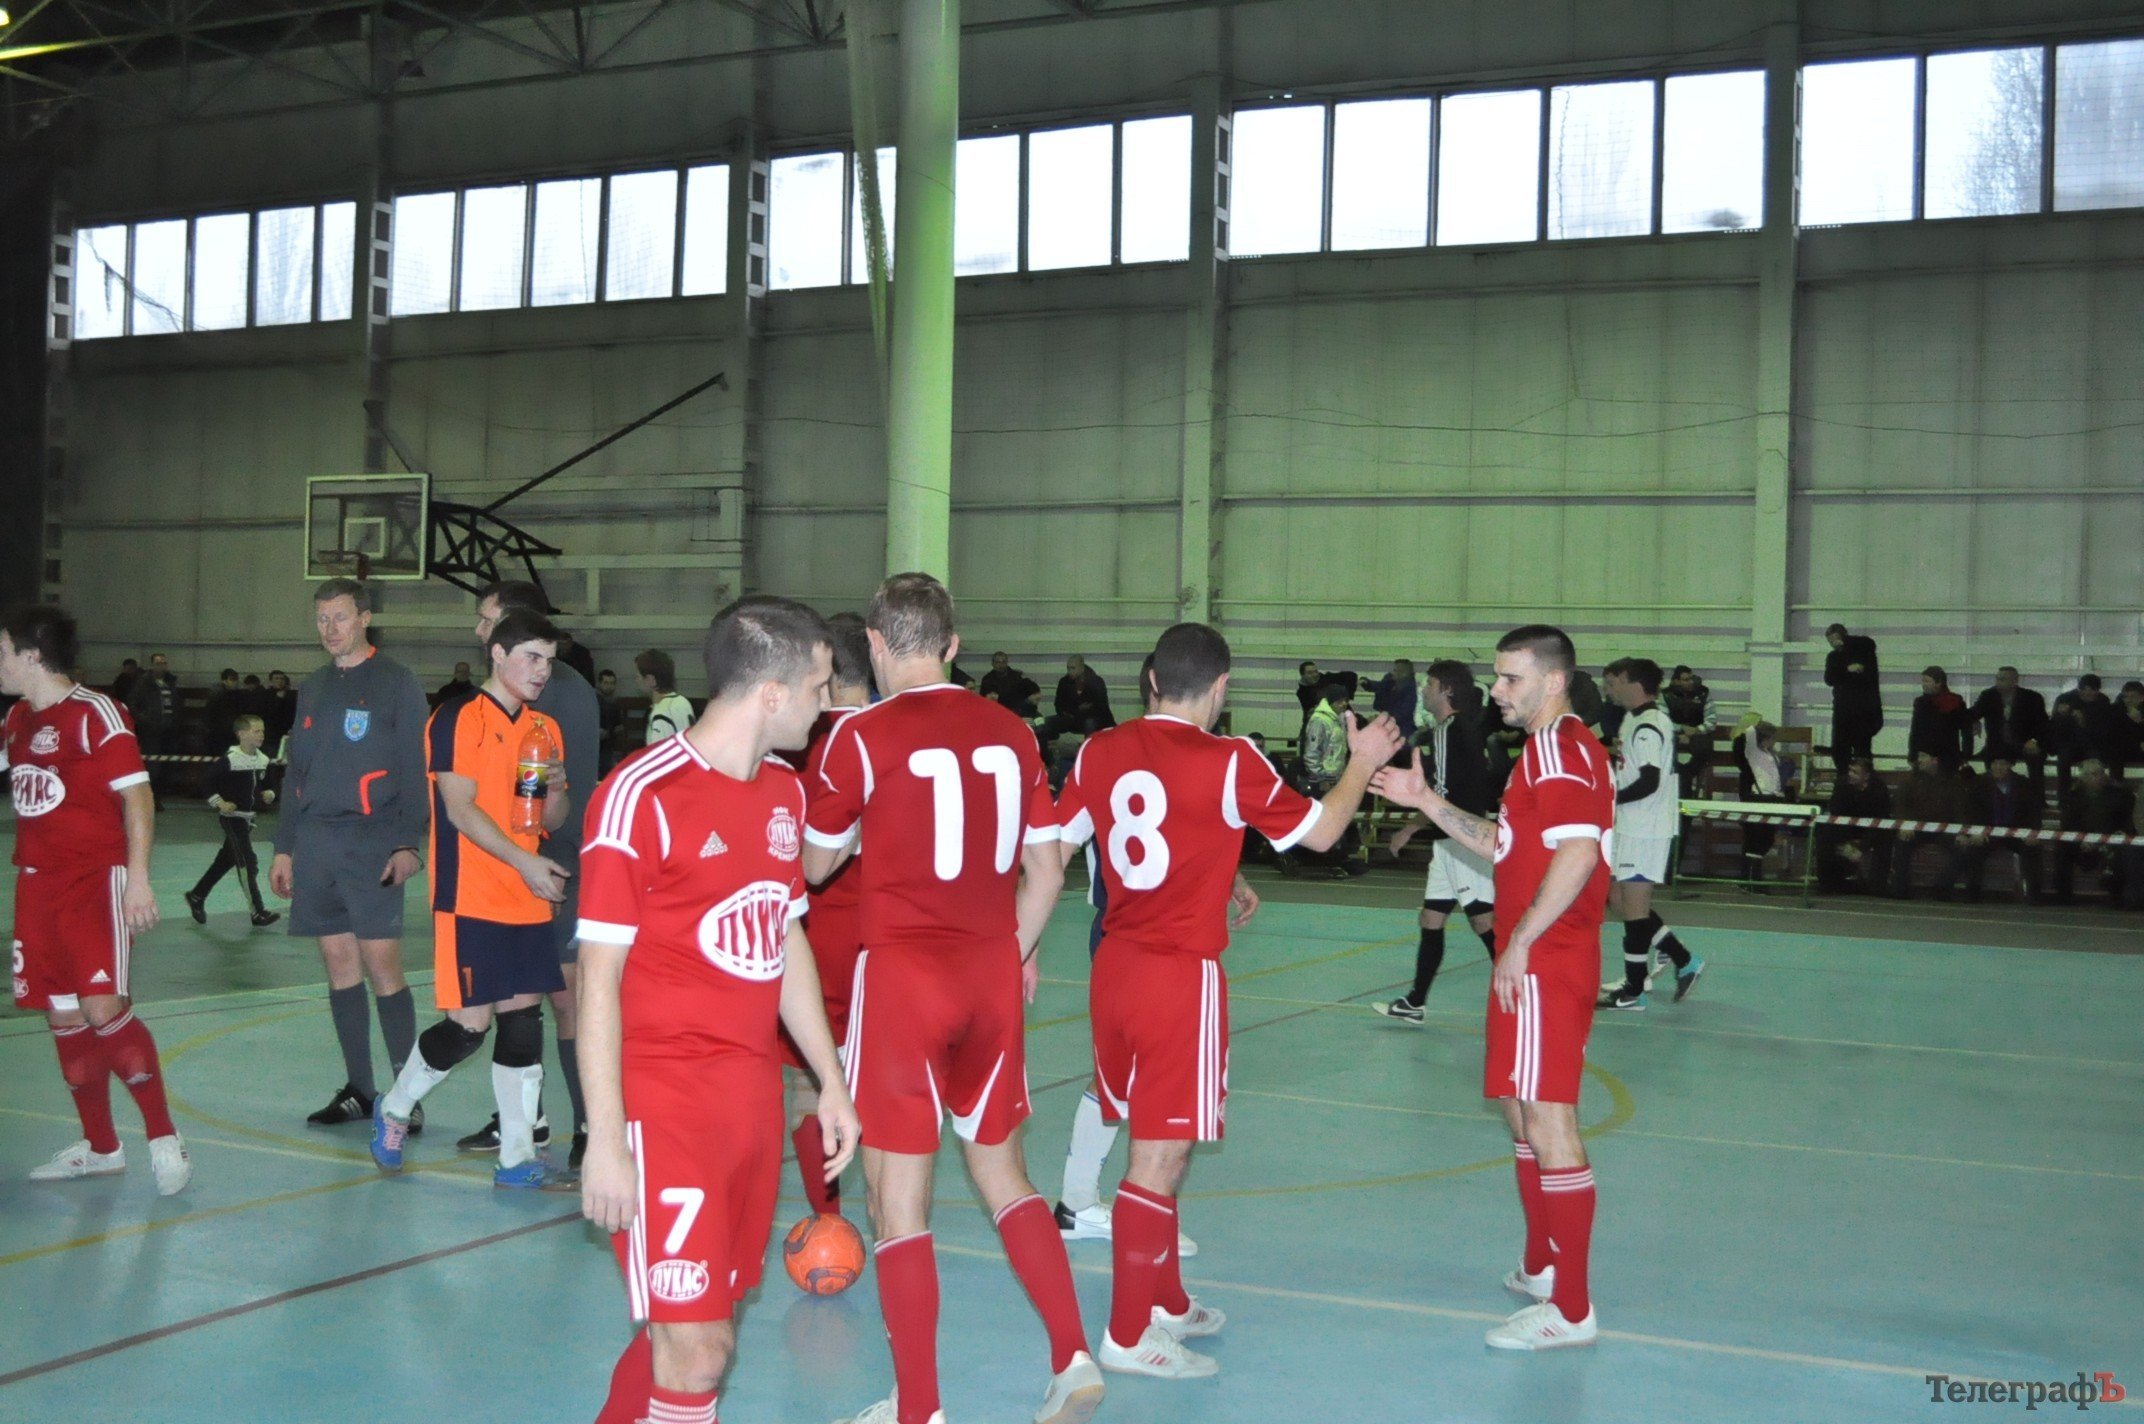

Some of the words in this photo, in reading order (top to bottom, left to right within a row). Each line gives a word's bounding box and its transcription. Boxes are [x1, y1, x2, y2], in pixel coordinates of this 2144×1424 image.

[909, 745, 1022, 881] 11
[1107, 769, 1170, 891] 8
[462, 966, 474, 998] 1
[659, 1186, 706, 1255] 7
[652, 1266, 704, 1295] ЛУКАС
